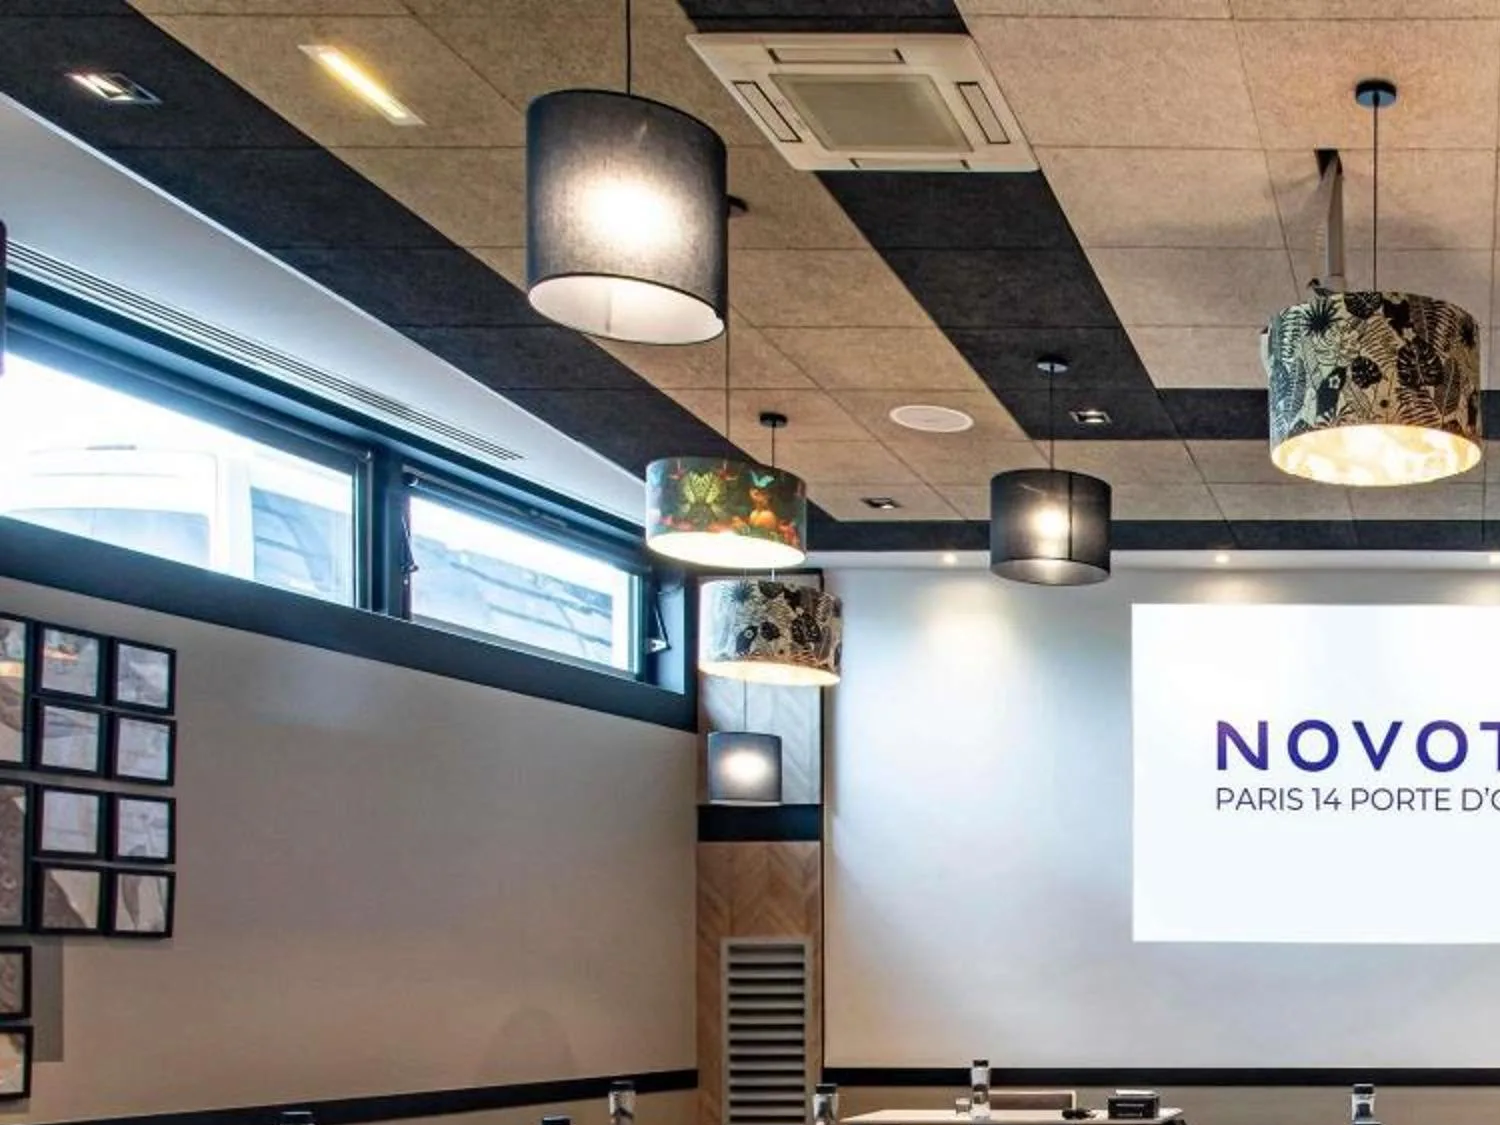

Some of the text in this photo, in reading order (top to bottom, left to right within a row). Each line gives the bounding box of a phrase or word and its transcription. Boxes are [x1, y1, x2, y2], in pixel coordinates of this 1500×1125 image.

[1216, 786, 1304, 811] PARIS
[1311, 787, 1342, 811] 14
[1351, 787, 1452, 812] PORTE
